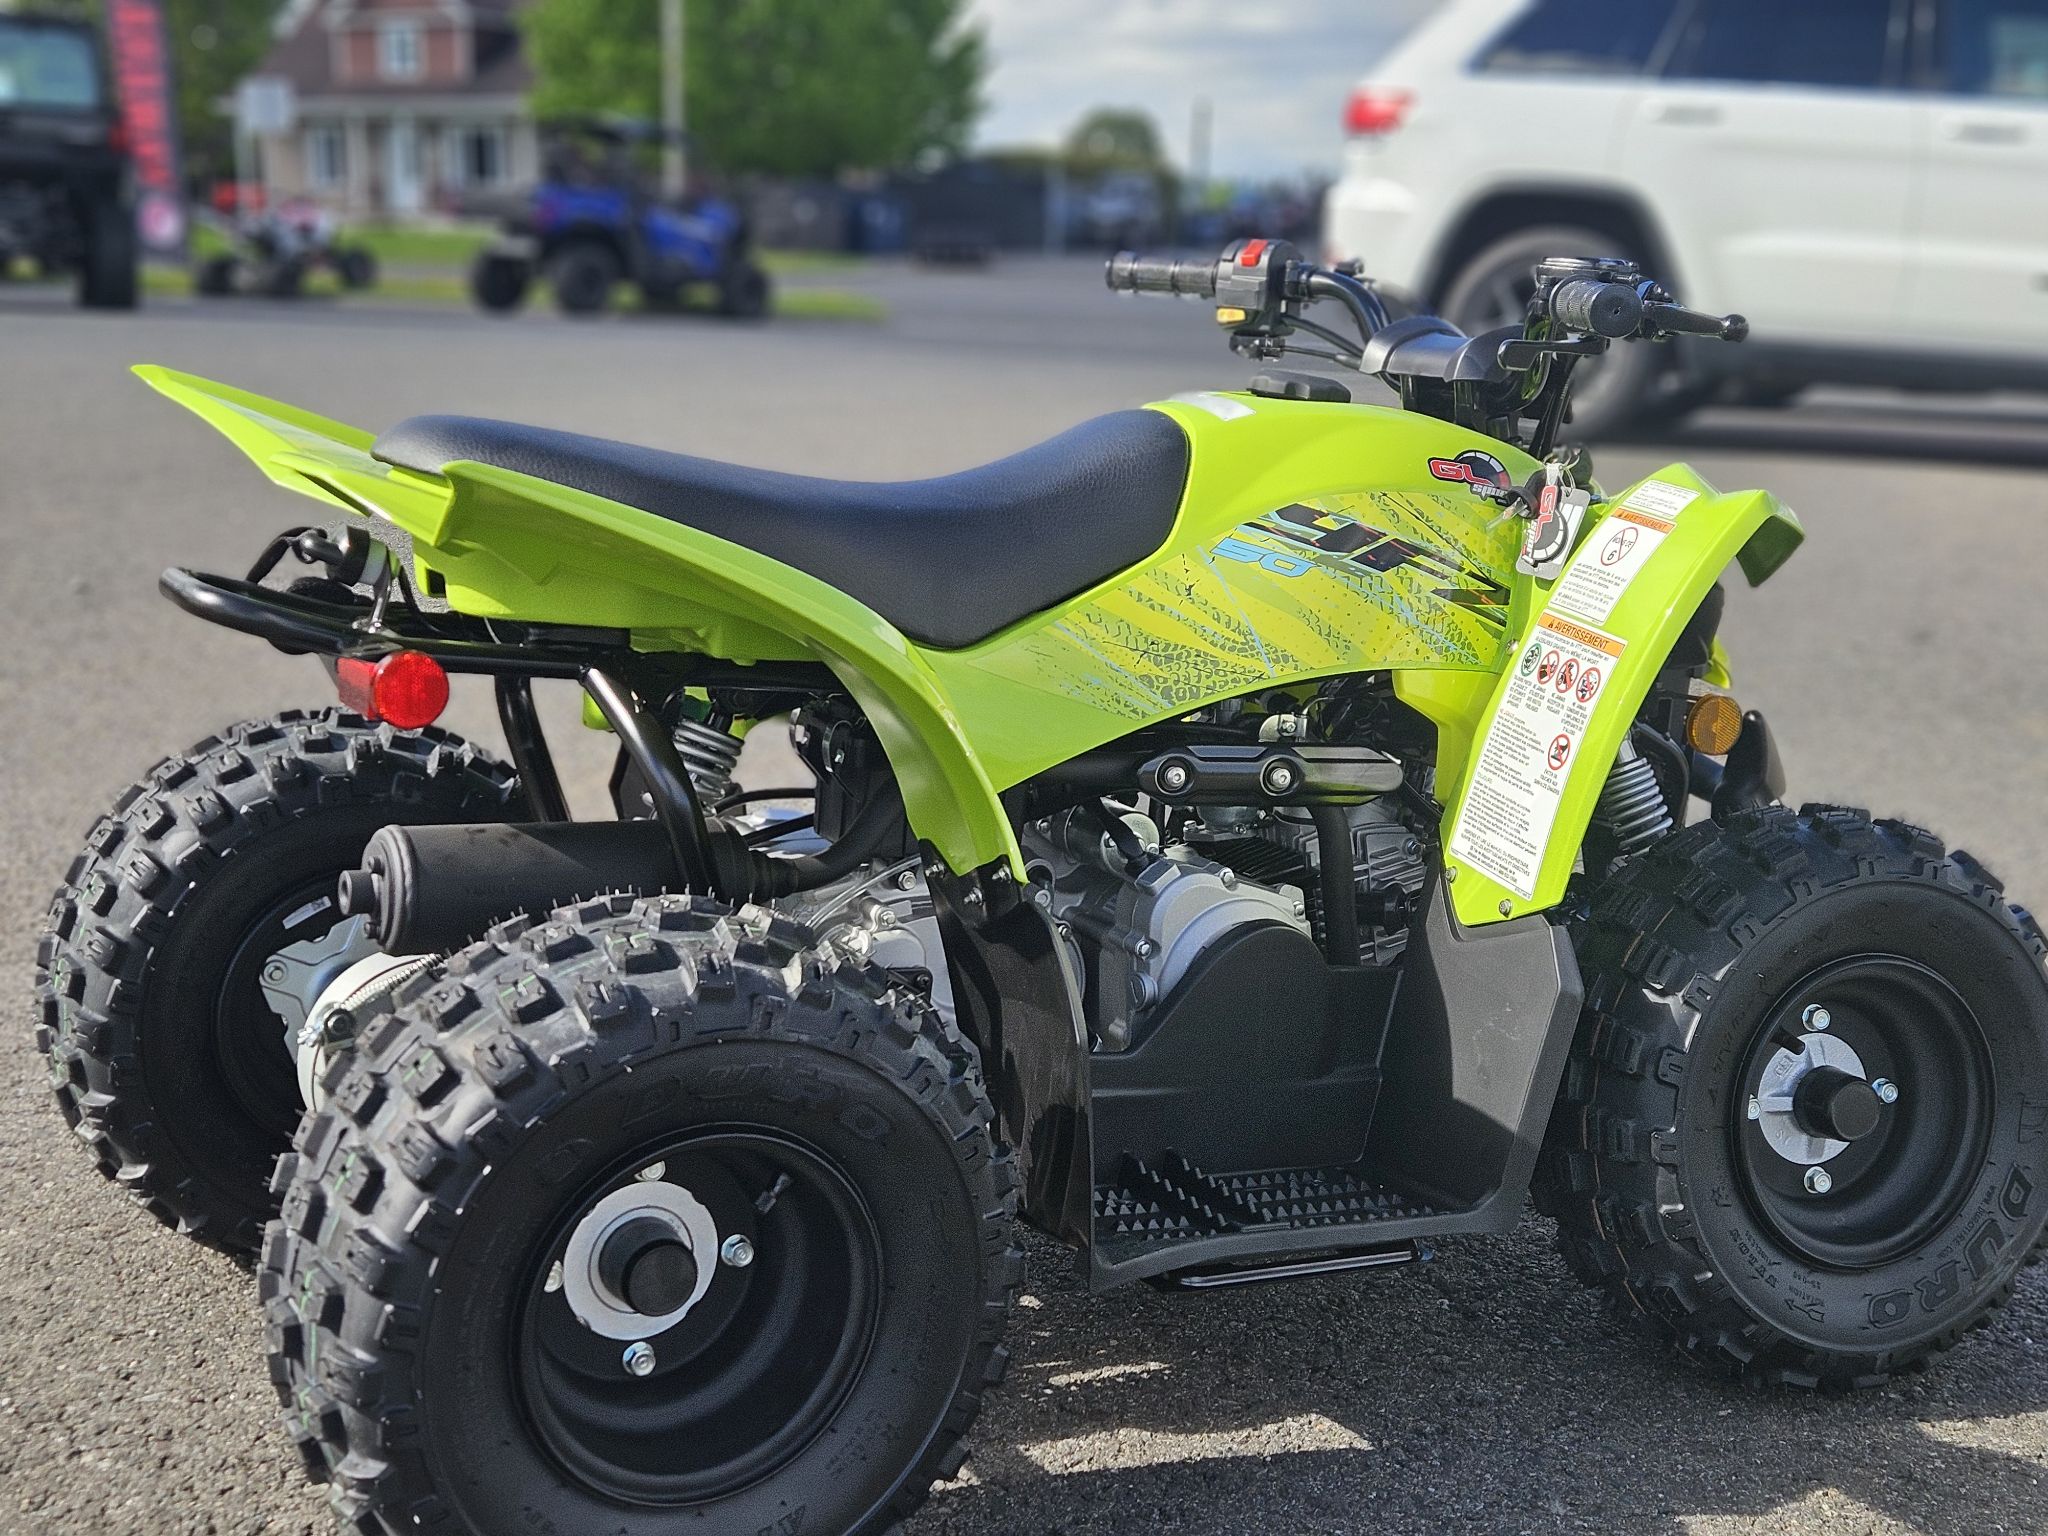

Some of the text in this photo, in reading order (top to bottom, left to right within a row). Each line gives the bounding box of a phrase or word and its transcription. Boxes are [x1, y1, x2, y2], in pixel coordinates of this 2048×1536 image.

[1430, 459, 1494, 487] GL
[1623, 511, 1668, 530] AVERTISSEMENT
[1210, 537, 1317, 578] 50
[1607, 549, 1618, 561] 6
[1553, 620, 1609, 650] AVERTISSEMENT
[1864, 1161, 2035, 1330] DURO
